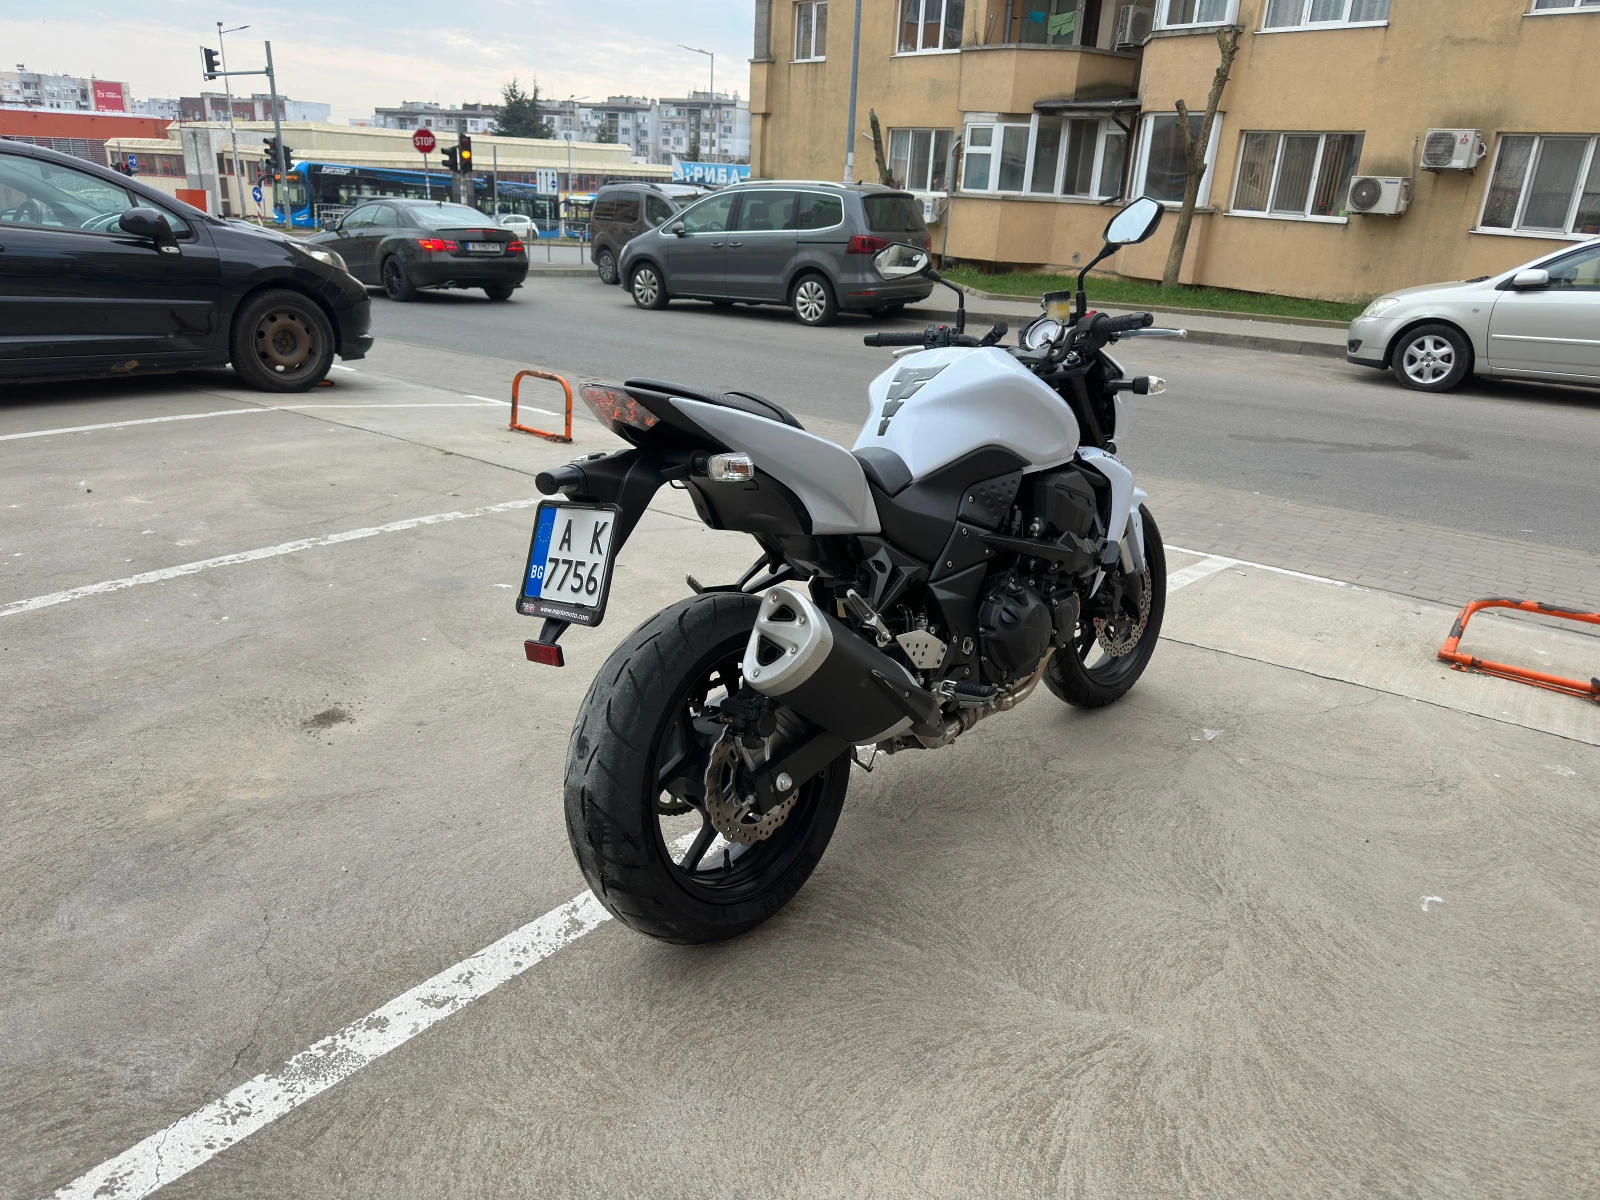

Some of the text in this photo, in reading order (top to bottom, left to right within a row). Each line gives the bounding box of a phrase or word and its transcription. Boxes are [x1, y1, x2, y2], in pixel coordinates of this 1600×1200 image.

[415, 136, 434, 146] STOP
[694, 166, 741, 185] РИБА
[558, 519, 609, 555] A K
[530, 564, 543, 580] BG
[543, 557, 600, 596] 7756
[540, 607, 590, 620] www.mariomoto.com
